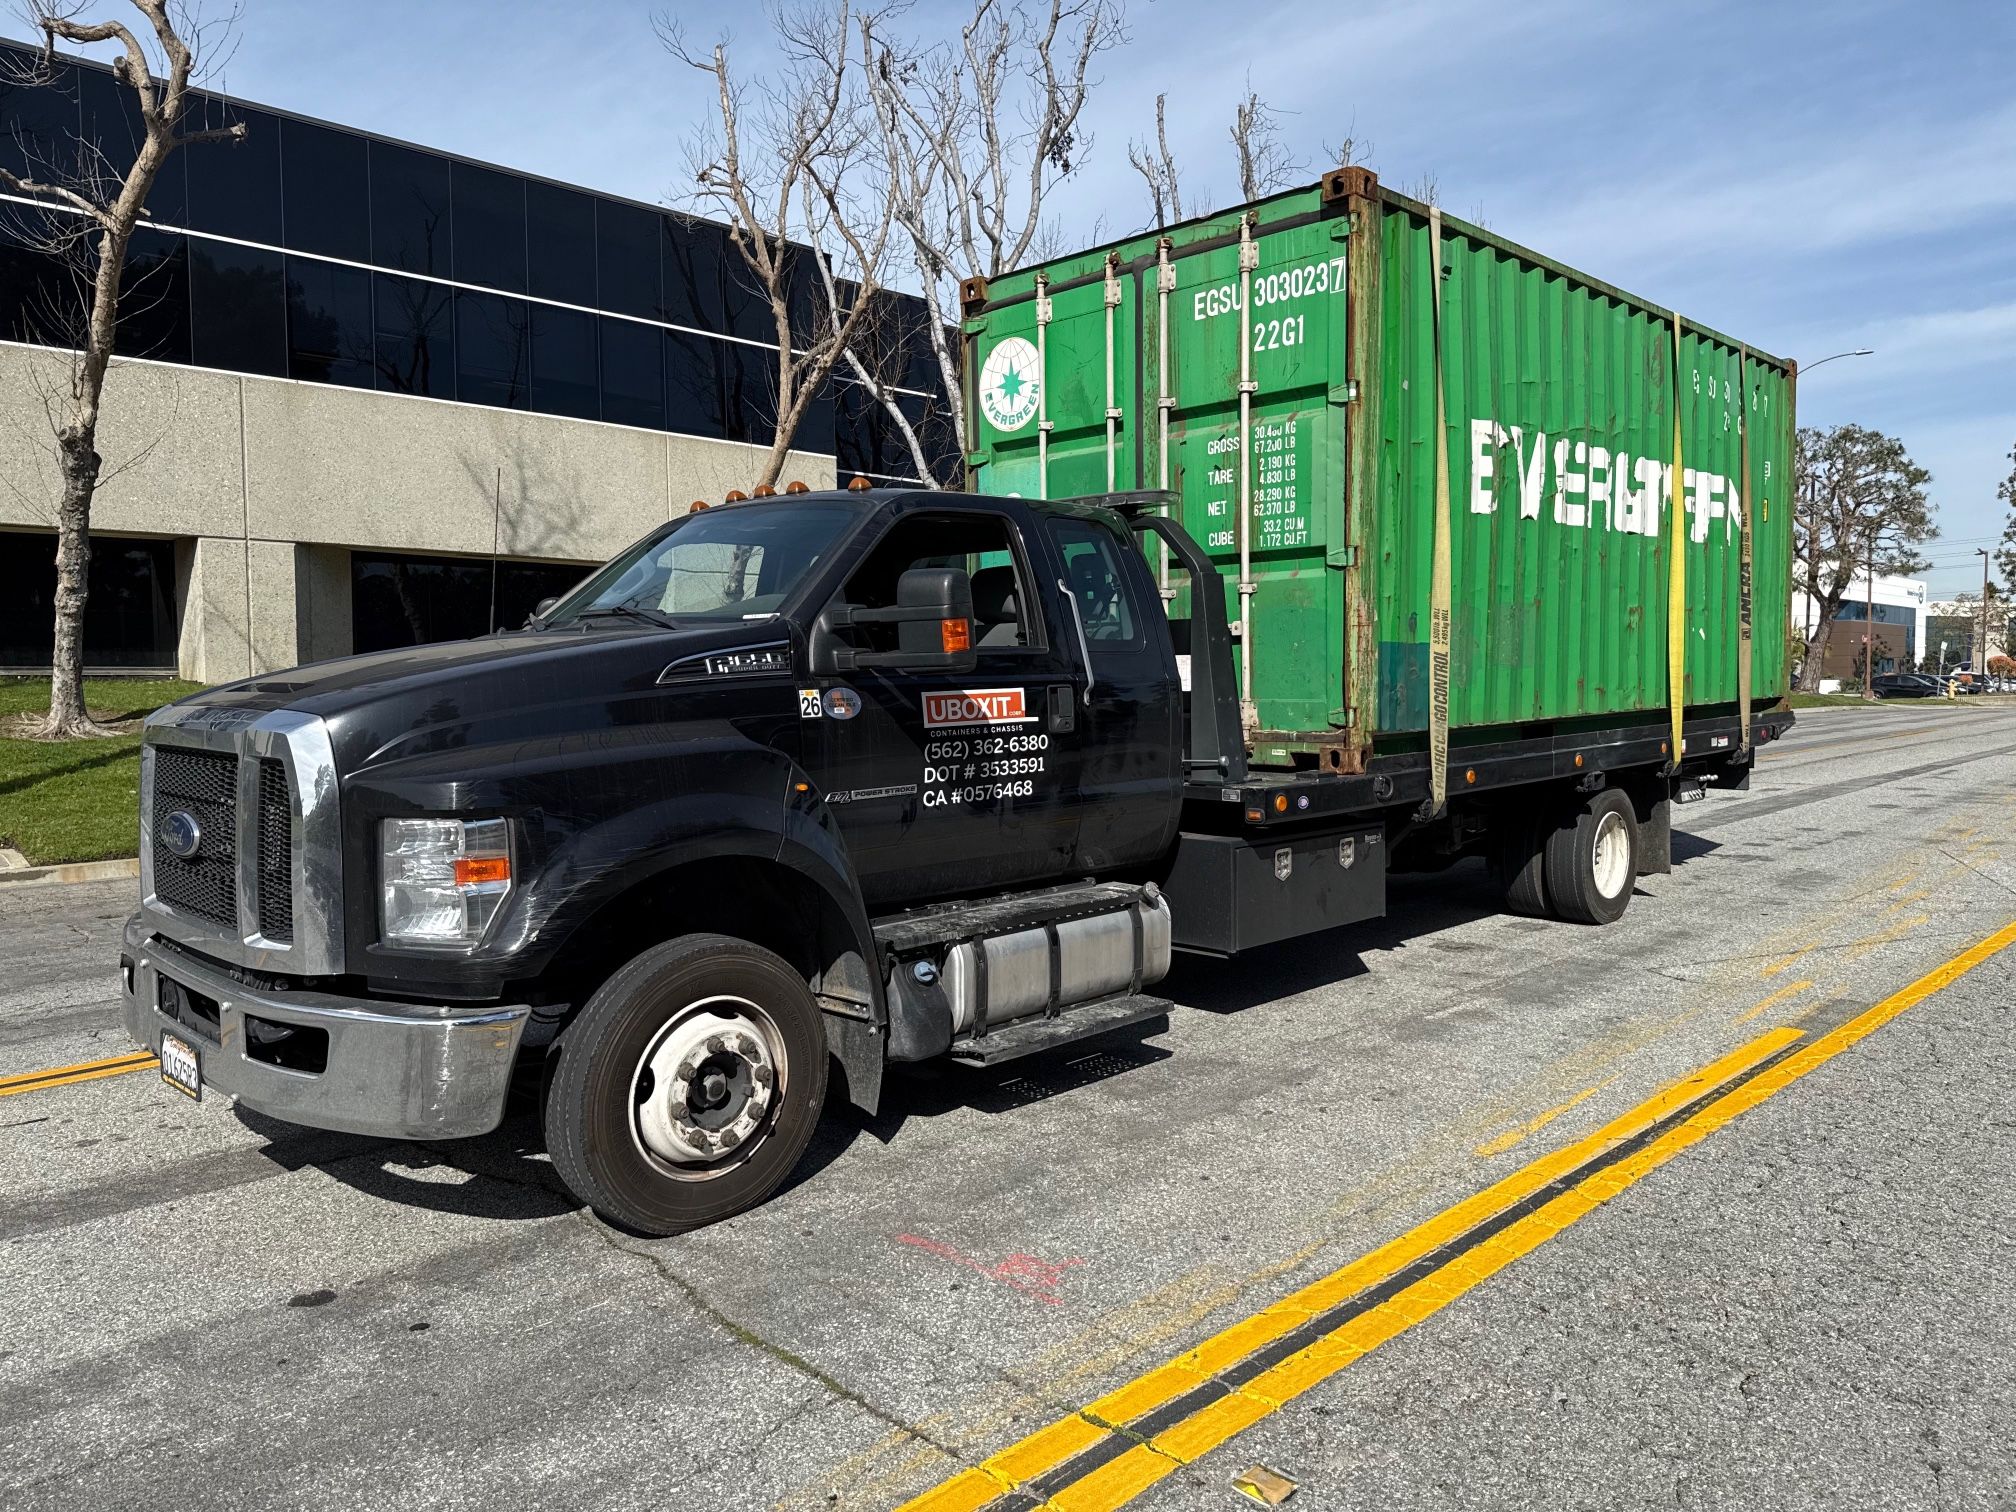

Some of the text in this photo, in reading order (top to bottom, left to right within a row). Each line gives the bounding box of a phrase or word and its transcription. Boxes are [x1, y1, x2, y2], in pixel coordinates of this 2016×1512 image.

[1194, 283, 1242, 321] EGSU
[1253, 314, 1304, 352] 22G1
[1285, 421, 1297, 434] KG
[1207, 437, 1240, 454] GROSS
[1285, 437, 1296, 449] LB
[1260, 454, 1296, 470] 2.190 KG
[1208, 469, 1234, 485] TARE
[1259, 469, 1296, 485] 4.830 LB
[1254, 486, 1296, 503] 28.290 KG
[1207, 501, 1227, 516] NET
[1254, 501, 1296, 517] 62.370 LB
[1263, 519, 1282, 533] 33.2
[1208, 531, 1235, 547] CUBE
[1259, 533, 1282, 548] 1.172
[1740, 562, 1751, 627] ANCRA
[802, 697, 820, 716] 26
[930, 697, 1011, 720] UBOXIT
[1434, 650, 1449, 790] PACIFIC CARGO CONTROL
[930, 724, 1023, 738] CONTAINERS & CHASSIS
[924, 734, 1049, 763] (562) 362-6380
[924, 757, 1045, 783] DOT # 3533591
[854, 789, 883, 798] POWER
[884, 785, 916, 795] STROKE
[922, 789, 948, 807] CA
[161, 819, 184, 846] Ford
